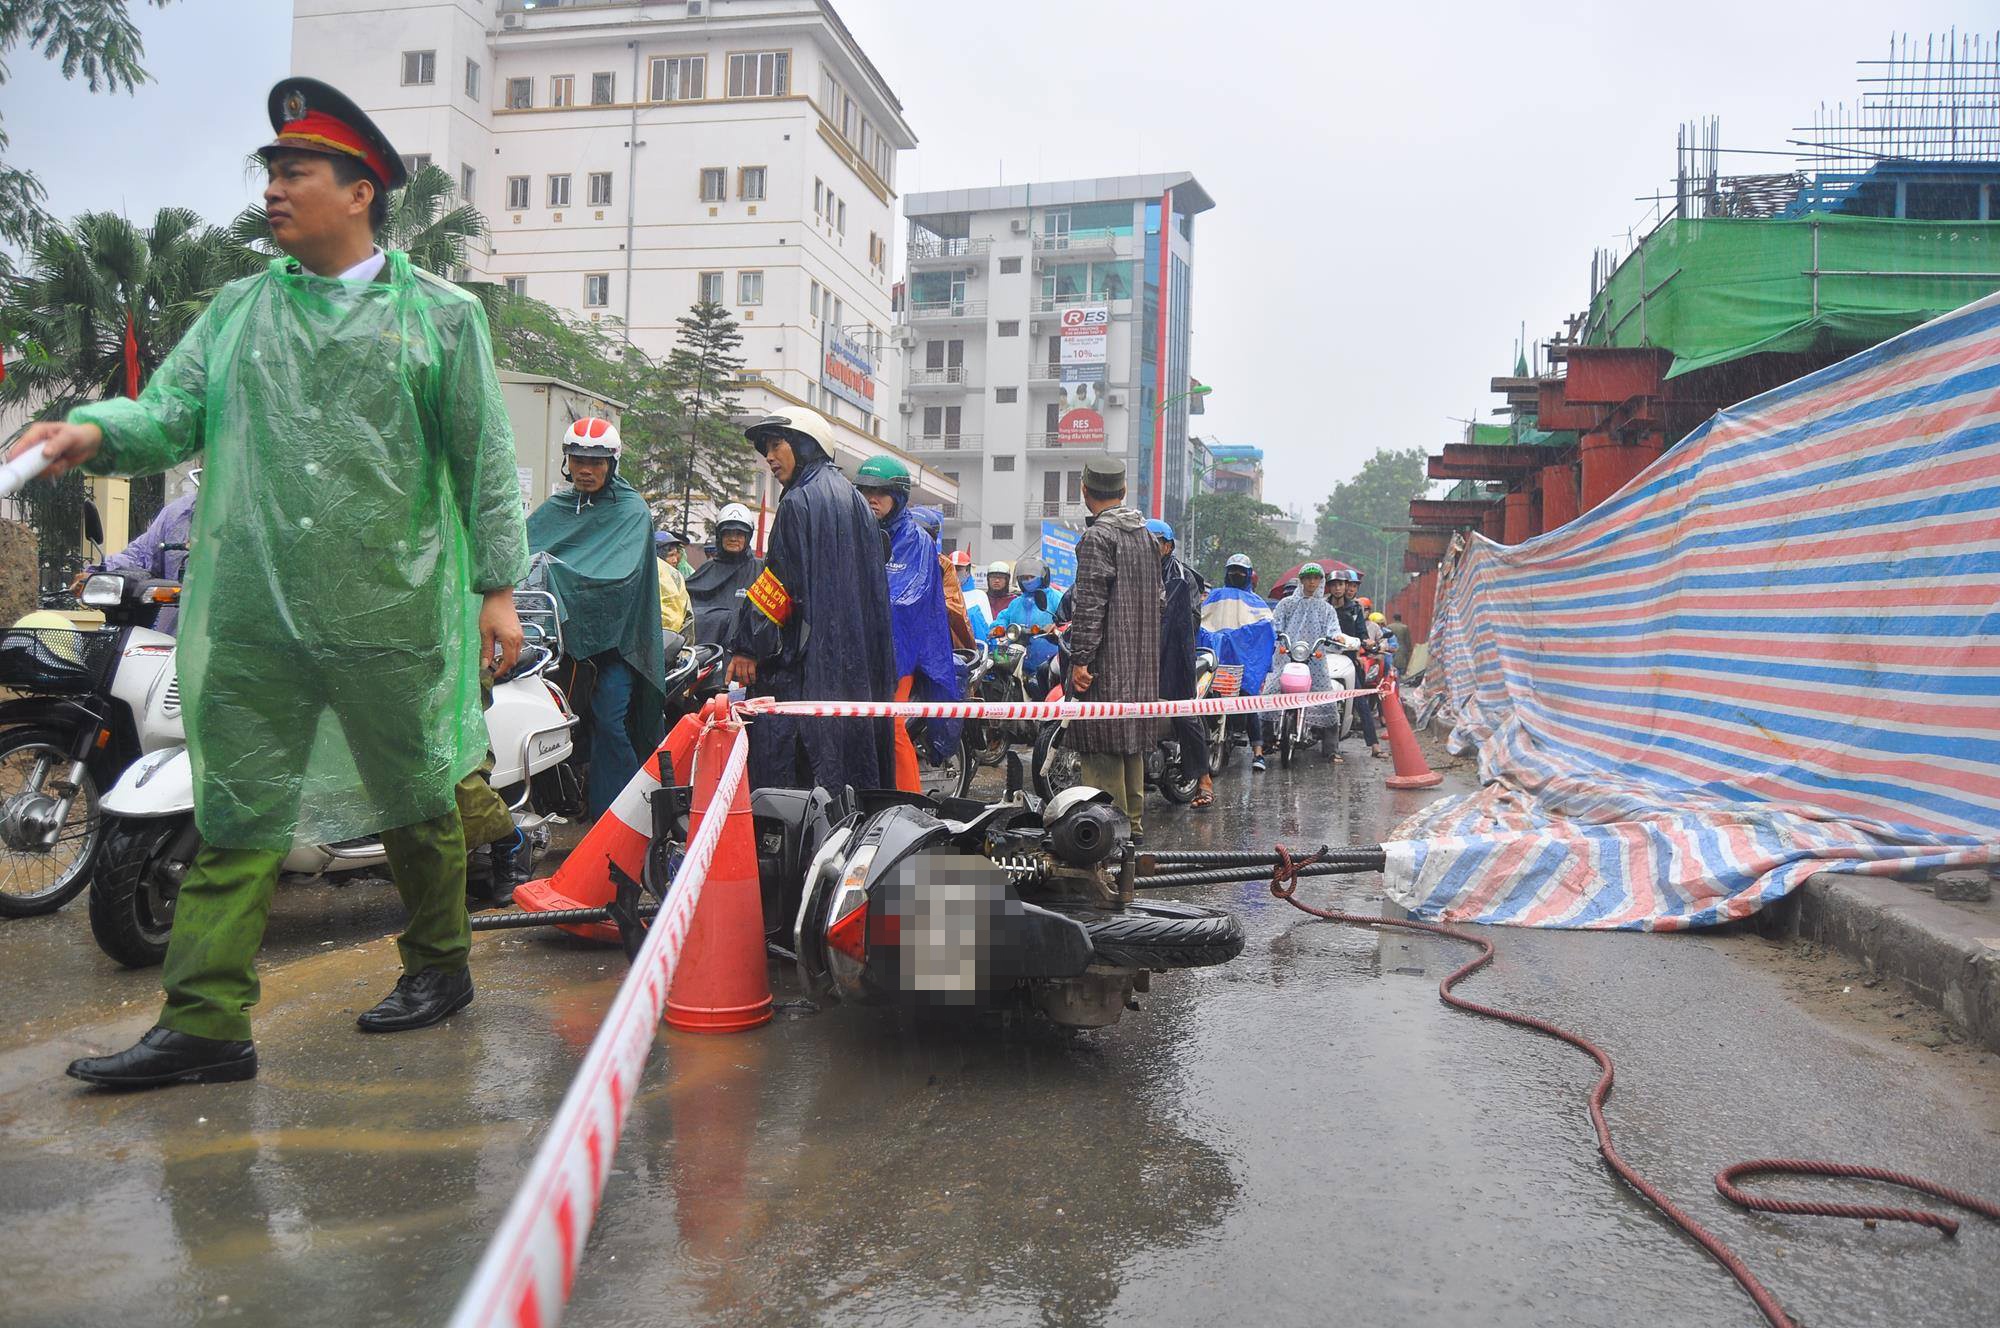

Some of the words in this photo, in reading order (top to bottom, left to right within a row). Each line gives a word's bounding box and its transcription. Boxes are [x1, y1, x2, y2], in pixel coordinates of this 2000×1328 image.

[1063, 310, 1106, 325] RES
[1073, 350, 1092, 358] 10%
[1073, 420, 1089, 429] RES
